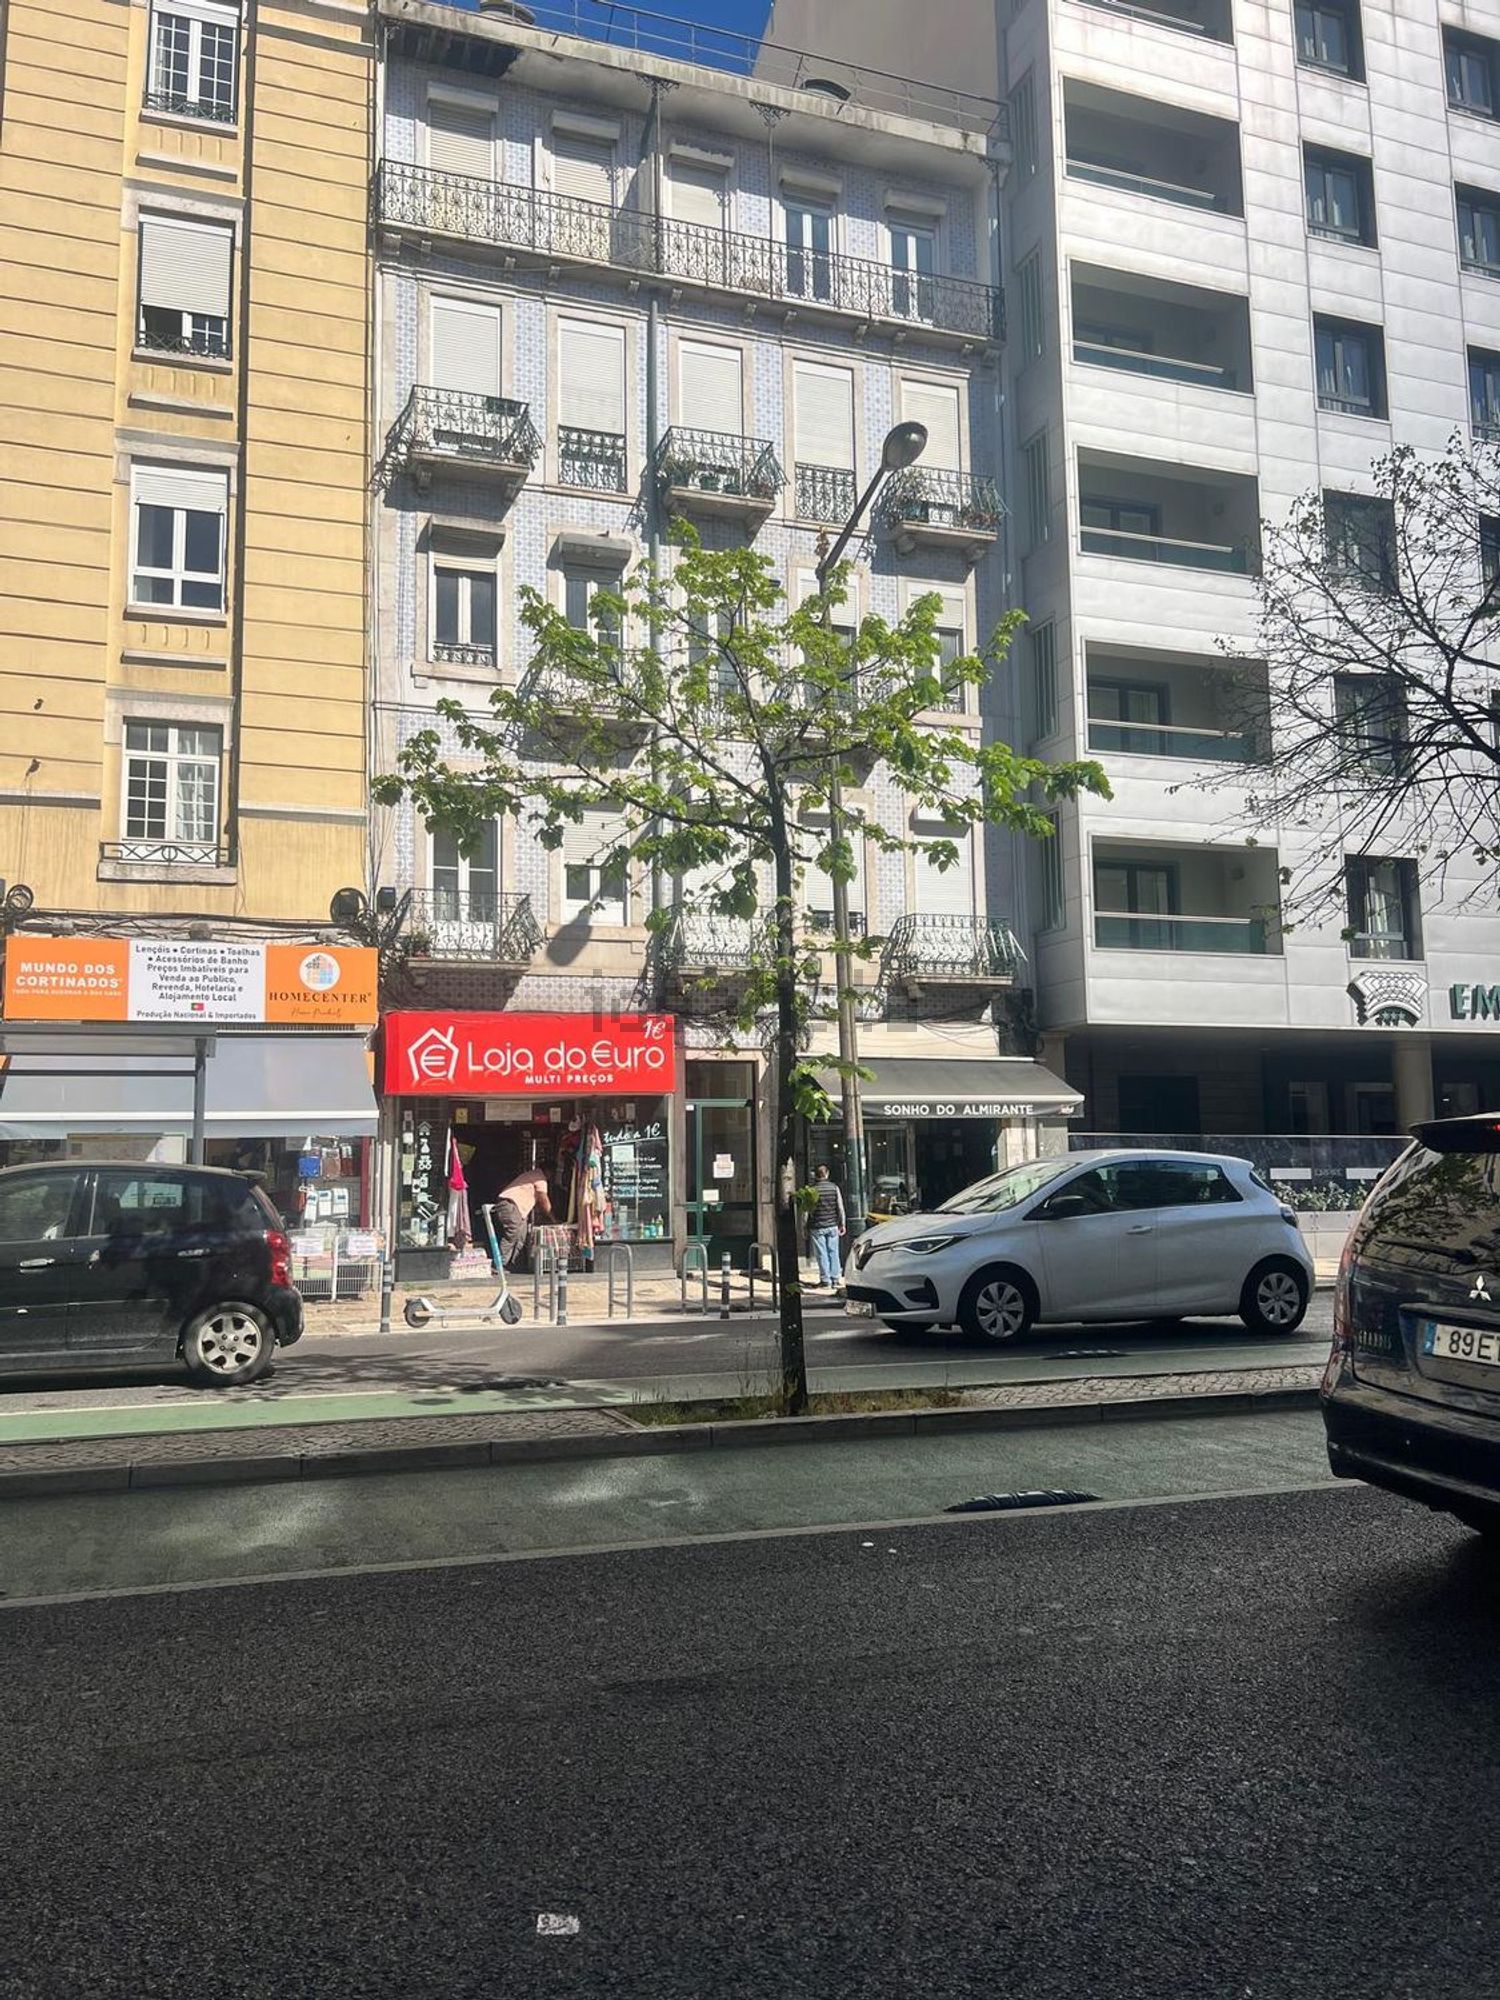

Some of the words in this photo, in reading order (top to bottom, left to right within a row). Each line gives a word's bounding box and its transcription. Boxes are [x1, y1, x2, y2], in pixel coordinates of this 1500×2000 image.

[136, 945, 170, 955] Lençóis
[180, 946, 217, 955] Cortinas
[227, 948, 260, 957] Toalhas
[155, 955, 205, 964] Acessórios
[207, 956, 218, 964] de
[221, 956, 248, 965] Banho
[20, 962, 78, 974] MUNDO
[84, 963, 116, 975] DOS
[147, 963, 178, 974] Preços
[228, 966, 249, 976] para
[16, 976, 119, 989] CORTINADOS
[159, 973, 186, 982] Venda
[189, 975, 200, 983] ao
[195, 983, 236, 992] Hotelaria
[159, 992, 210, 1003] Alojamento
[212, 993, 237, 1002] Local
[137, 1010, 172, 1020] Produção
[174, 1011, 206, 1019] Nacional
[467, 1041, 534, 1076] Loja
[543, 1040, 587, 1069] do
[524, 1074, 561, 1084] MULTI
[567, 1074, 614, 1086] PREÇOS
[884, 1104, 929, 1115] SONHO
[936, 1104, 956, 1115] DO
[963, 1104, 1034, 1115] ALMIRANTE
